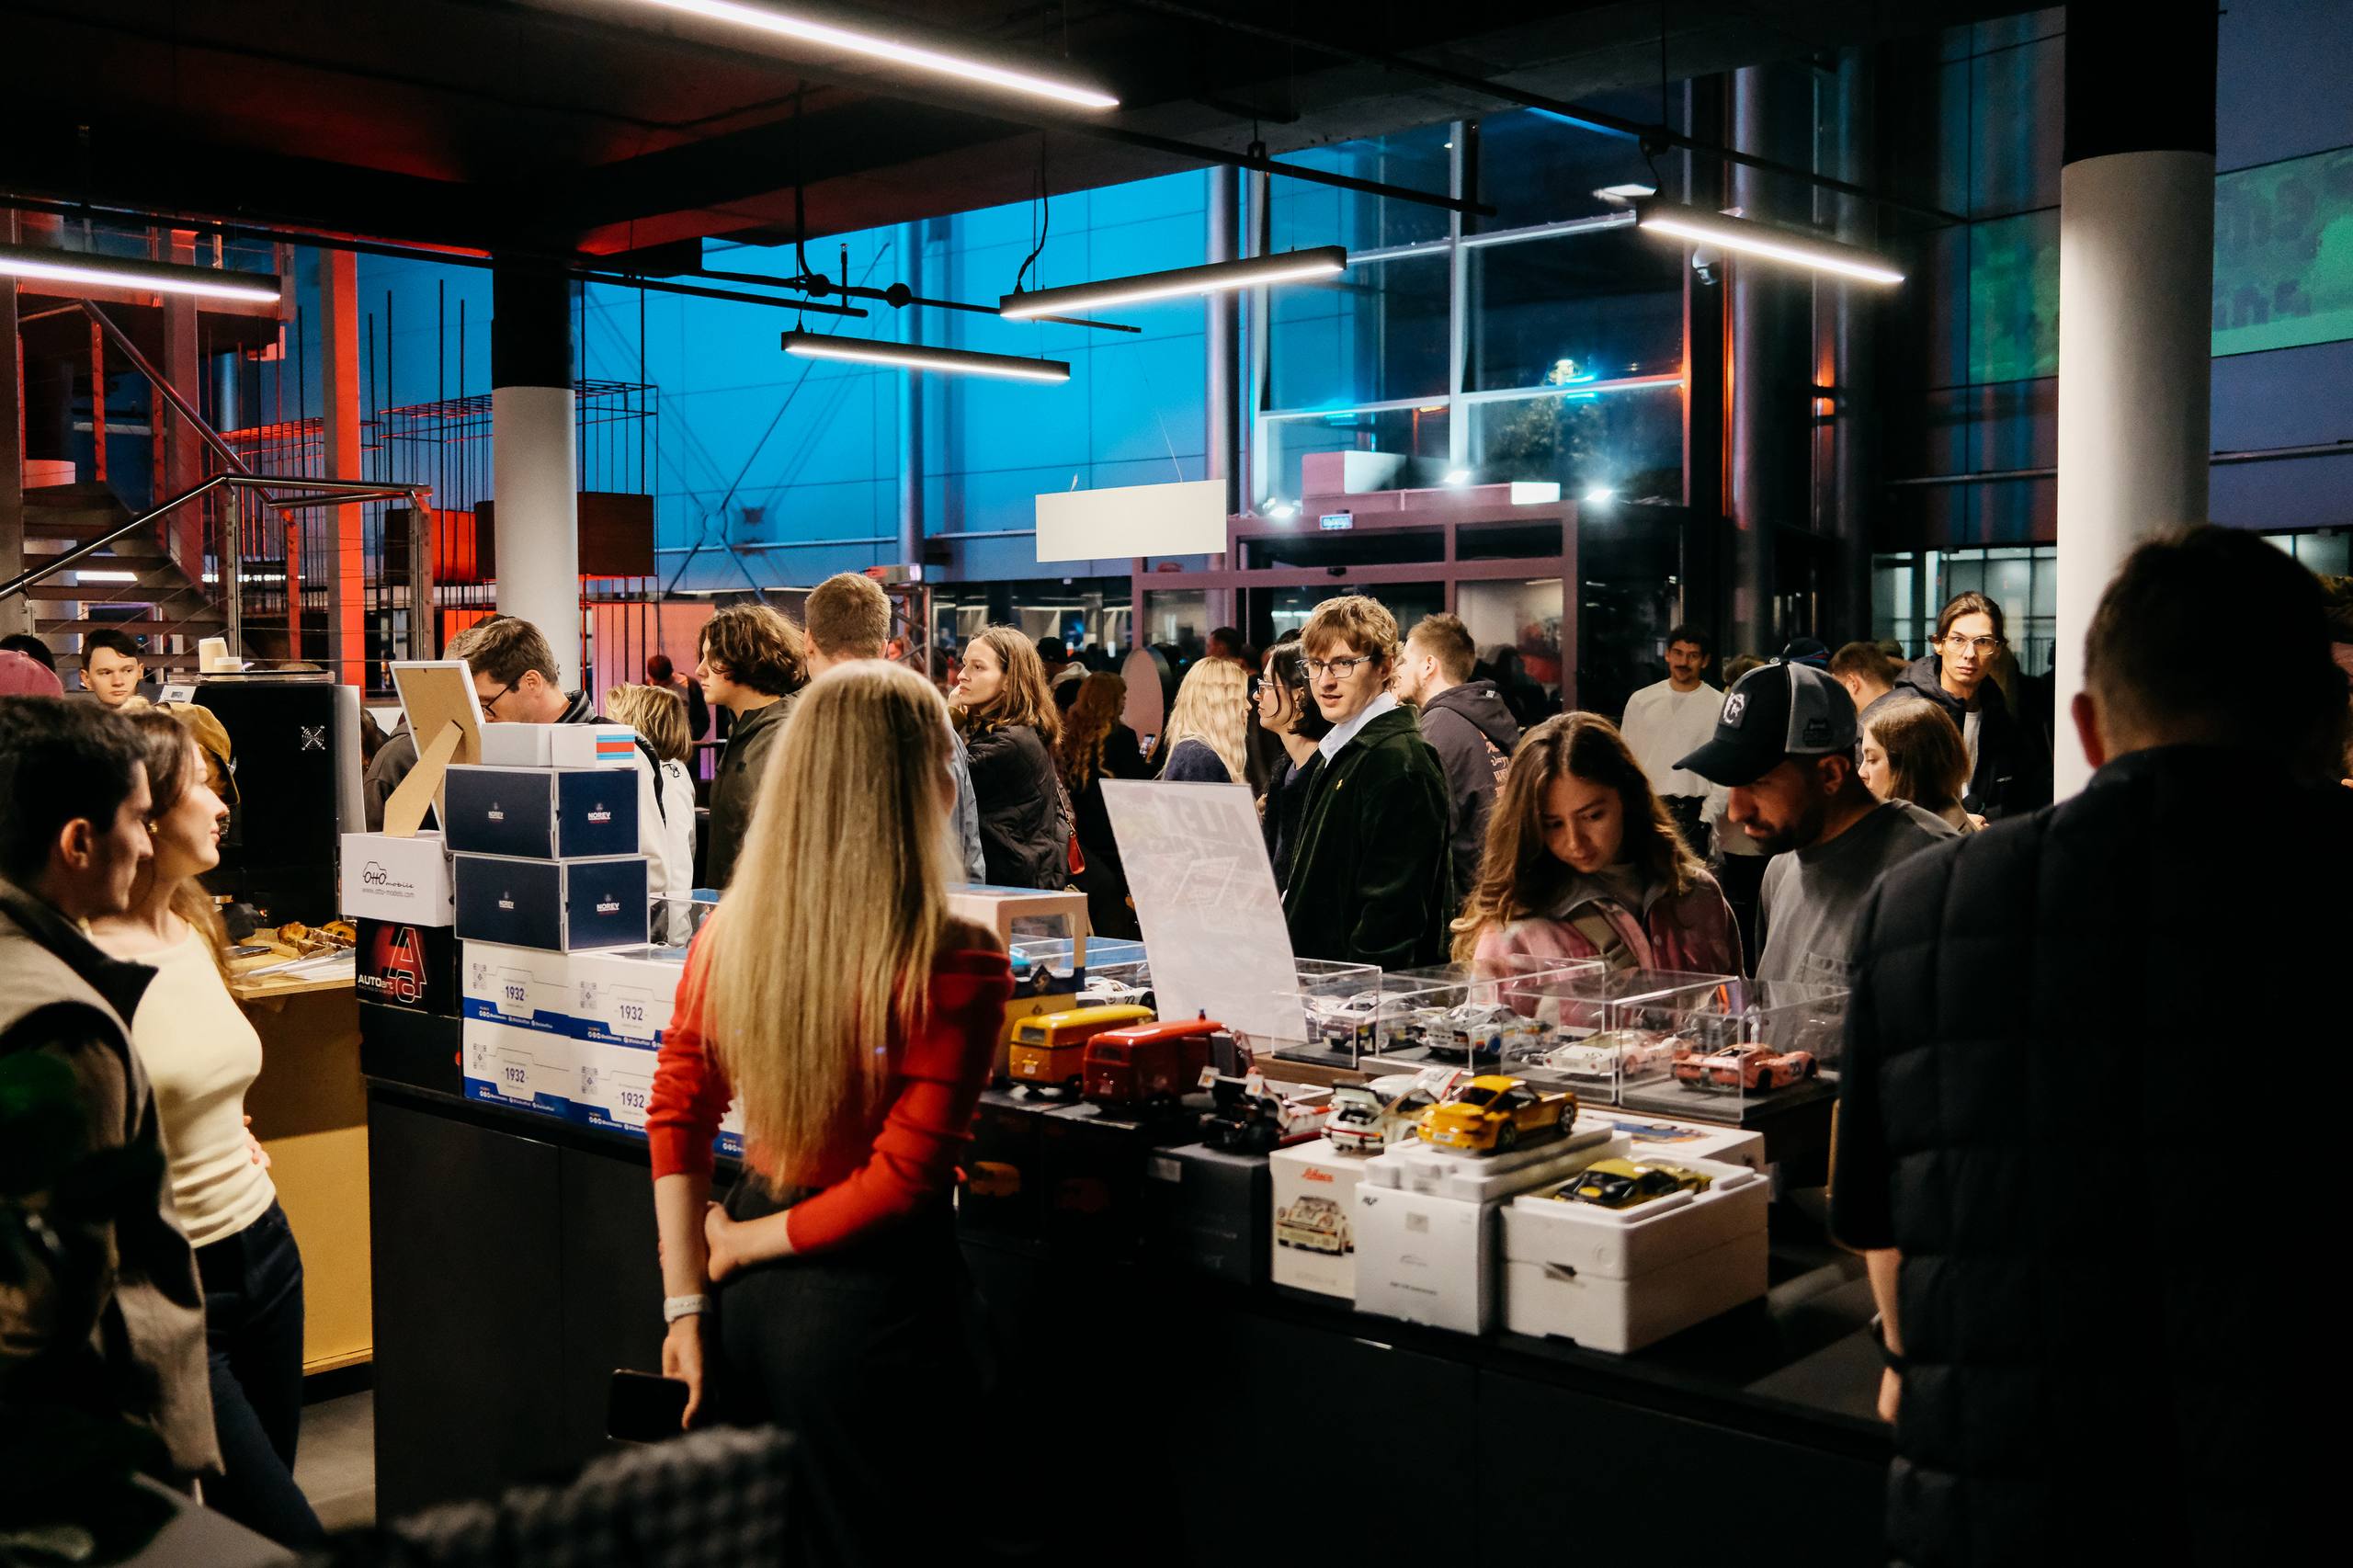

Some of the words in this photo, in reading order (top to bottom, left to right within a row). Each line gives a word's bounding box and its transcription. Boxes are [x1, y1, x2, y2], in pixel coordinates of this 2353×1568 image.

[358, 974, 394, 990] AUTOart
[505, 985, 525, 1001] 1932
[620, 1005, 643, 1021] 1932
[505, 1067, 526, 1083] 1932
[621, 1091, 645, 1108] 1932
